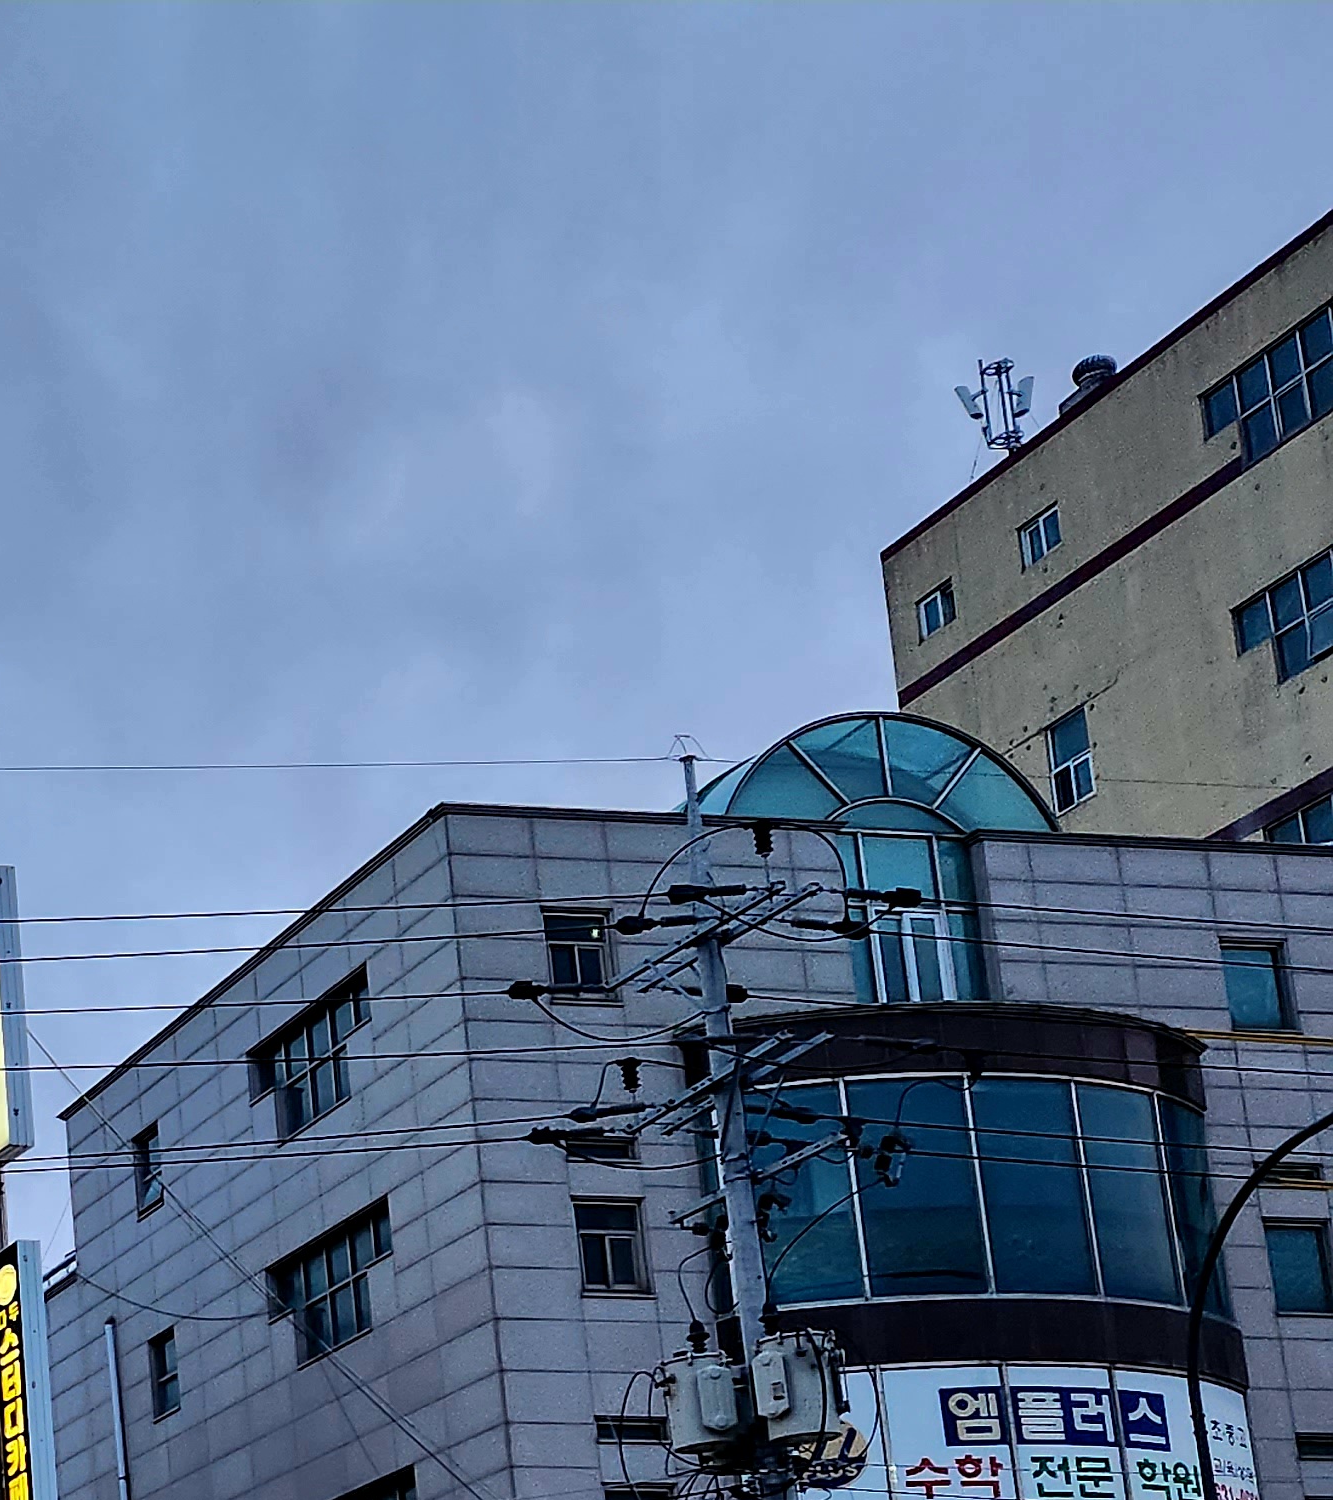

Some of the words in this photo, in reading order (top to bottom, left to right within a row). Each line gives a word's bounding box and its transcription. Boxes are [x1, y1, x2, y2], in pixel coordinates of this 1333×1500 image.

[947, 1391, 1167, 1445] 엠플러스
[905, 1454, 1004, 1500] 수학
[1030, 1455, 1117, 1500] 전문
